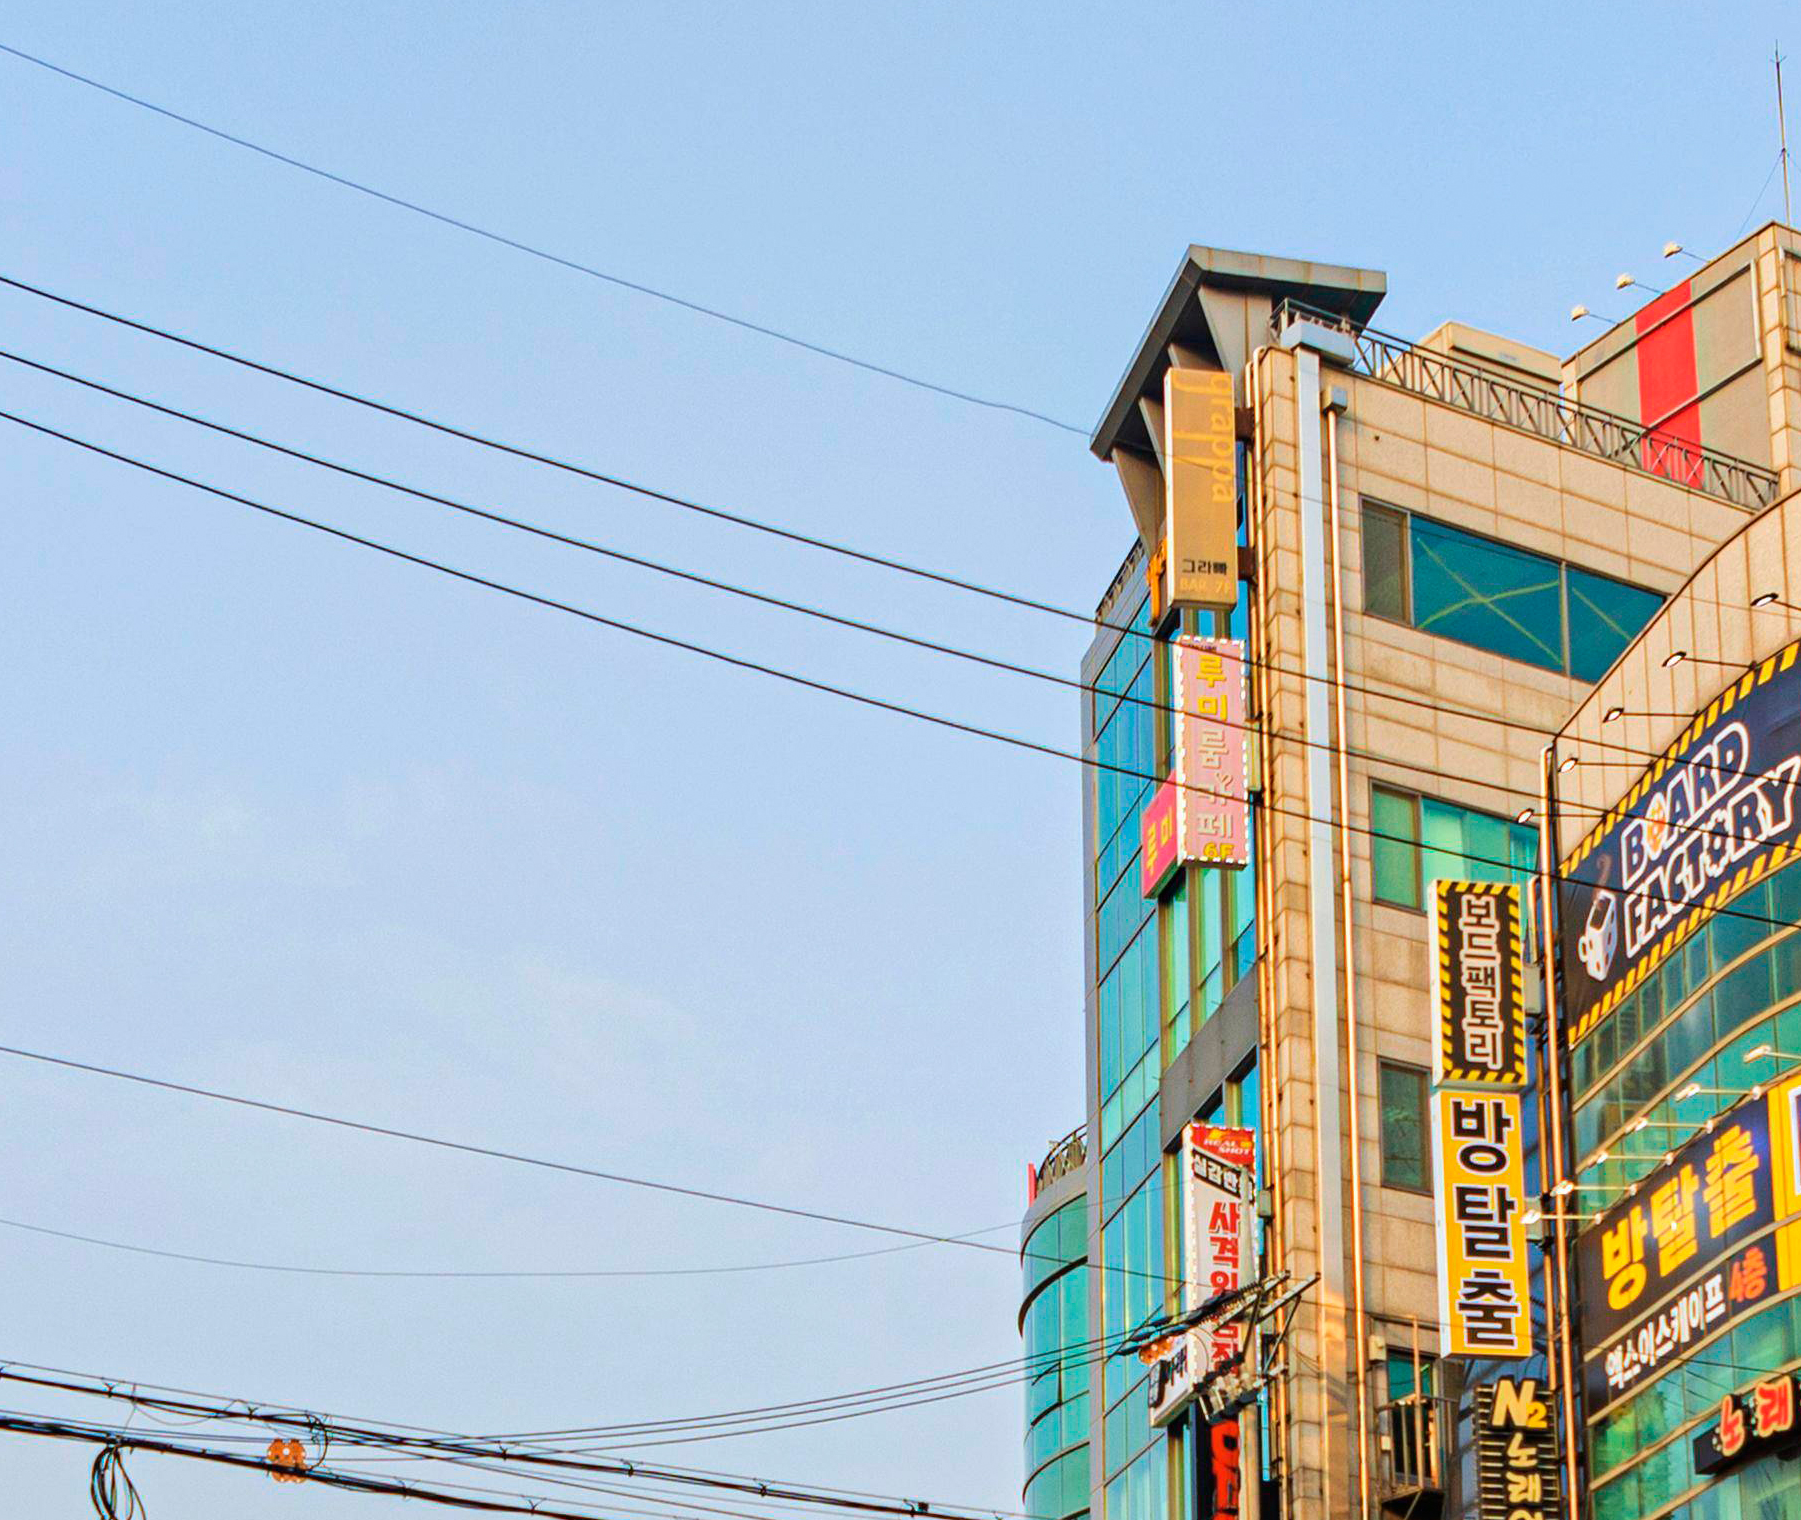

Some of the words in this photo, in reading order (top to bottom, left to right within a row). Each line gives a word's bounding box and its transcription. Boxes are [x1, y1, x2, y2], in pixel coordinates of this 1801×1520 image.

[1460, 893, 1503, 1070] 보드팩토리
[1452, 1100, 1516, 1350] 방탈출
[1601, 1126, 1760, 1311] 방탈출
[1493, 1377, 1547, 1430] N2
[1605, 1273, 1727, 1390] 엑스이스케이프
